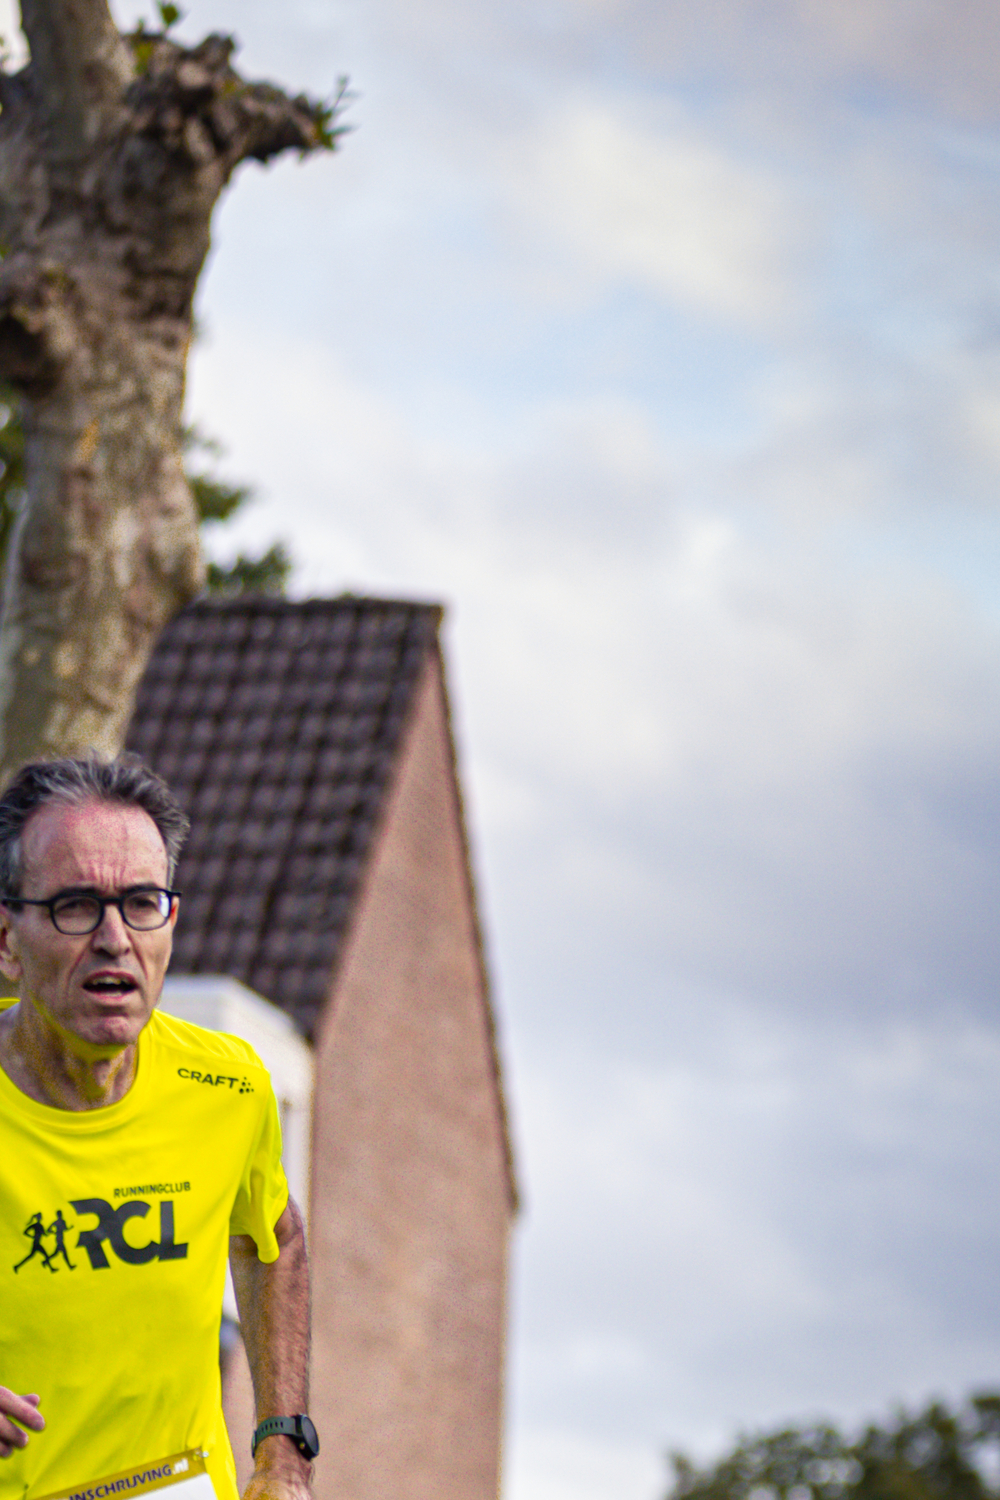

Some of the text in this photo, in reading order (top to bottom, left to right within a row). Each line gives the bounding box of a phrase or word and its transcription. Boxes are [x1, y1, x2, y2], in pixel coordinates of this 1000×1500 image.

[178, 1069, 239, 1089] CRAFT
[114, 1181, 192, 1198] RUNNINGCLUB
[69, 1198, 188, 1270] RCL
